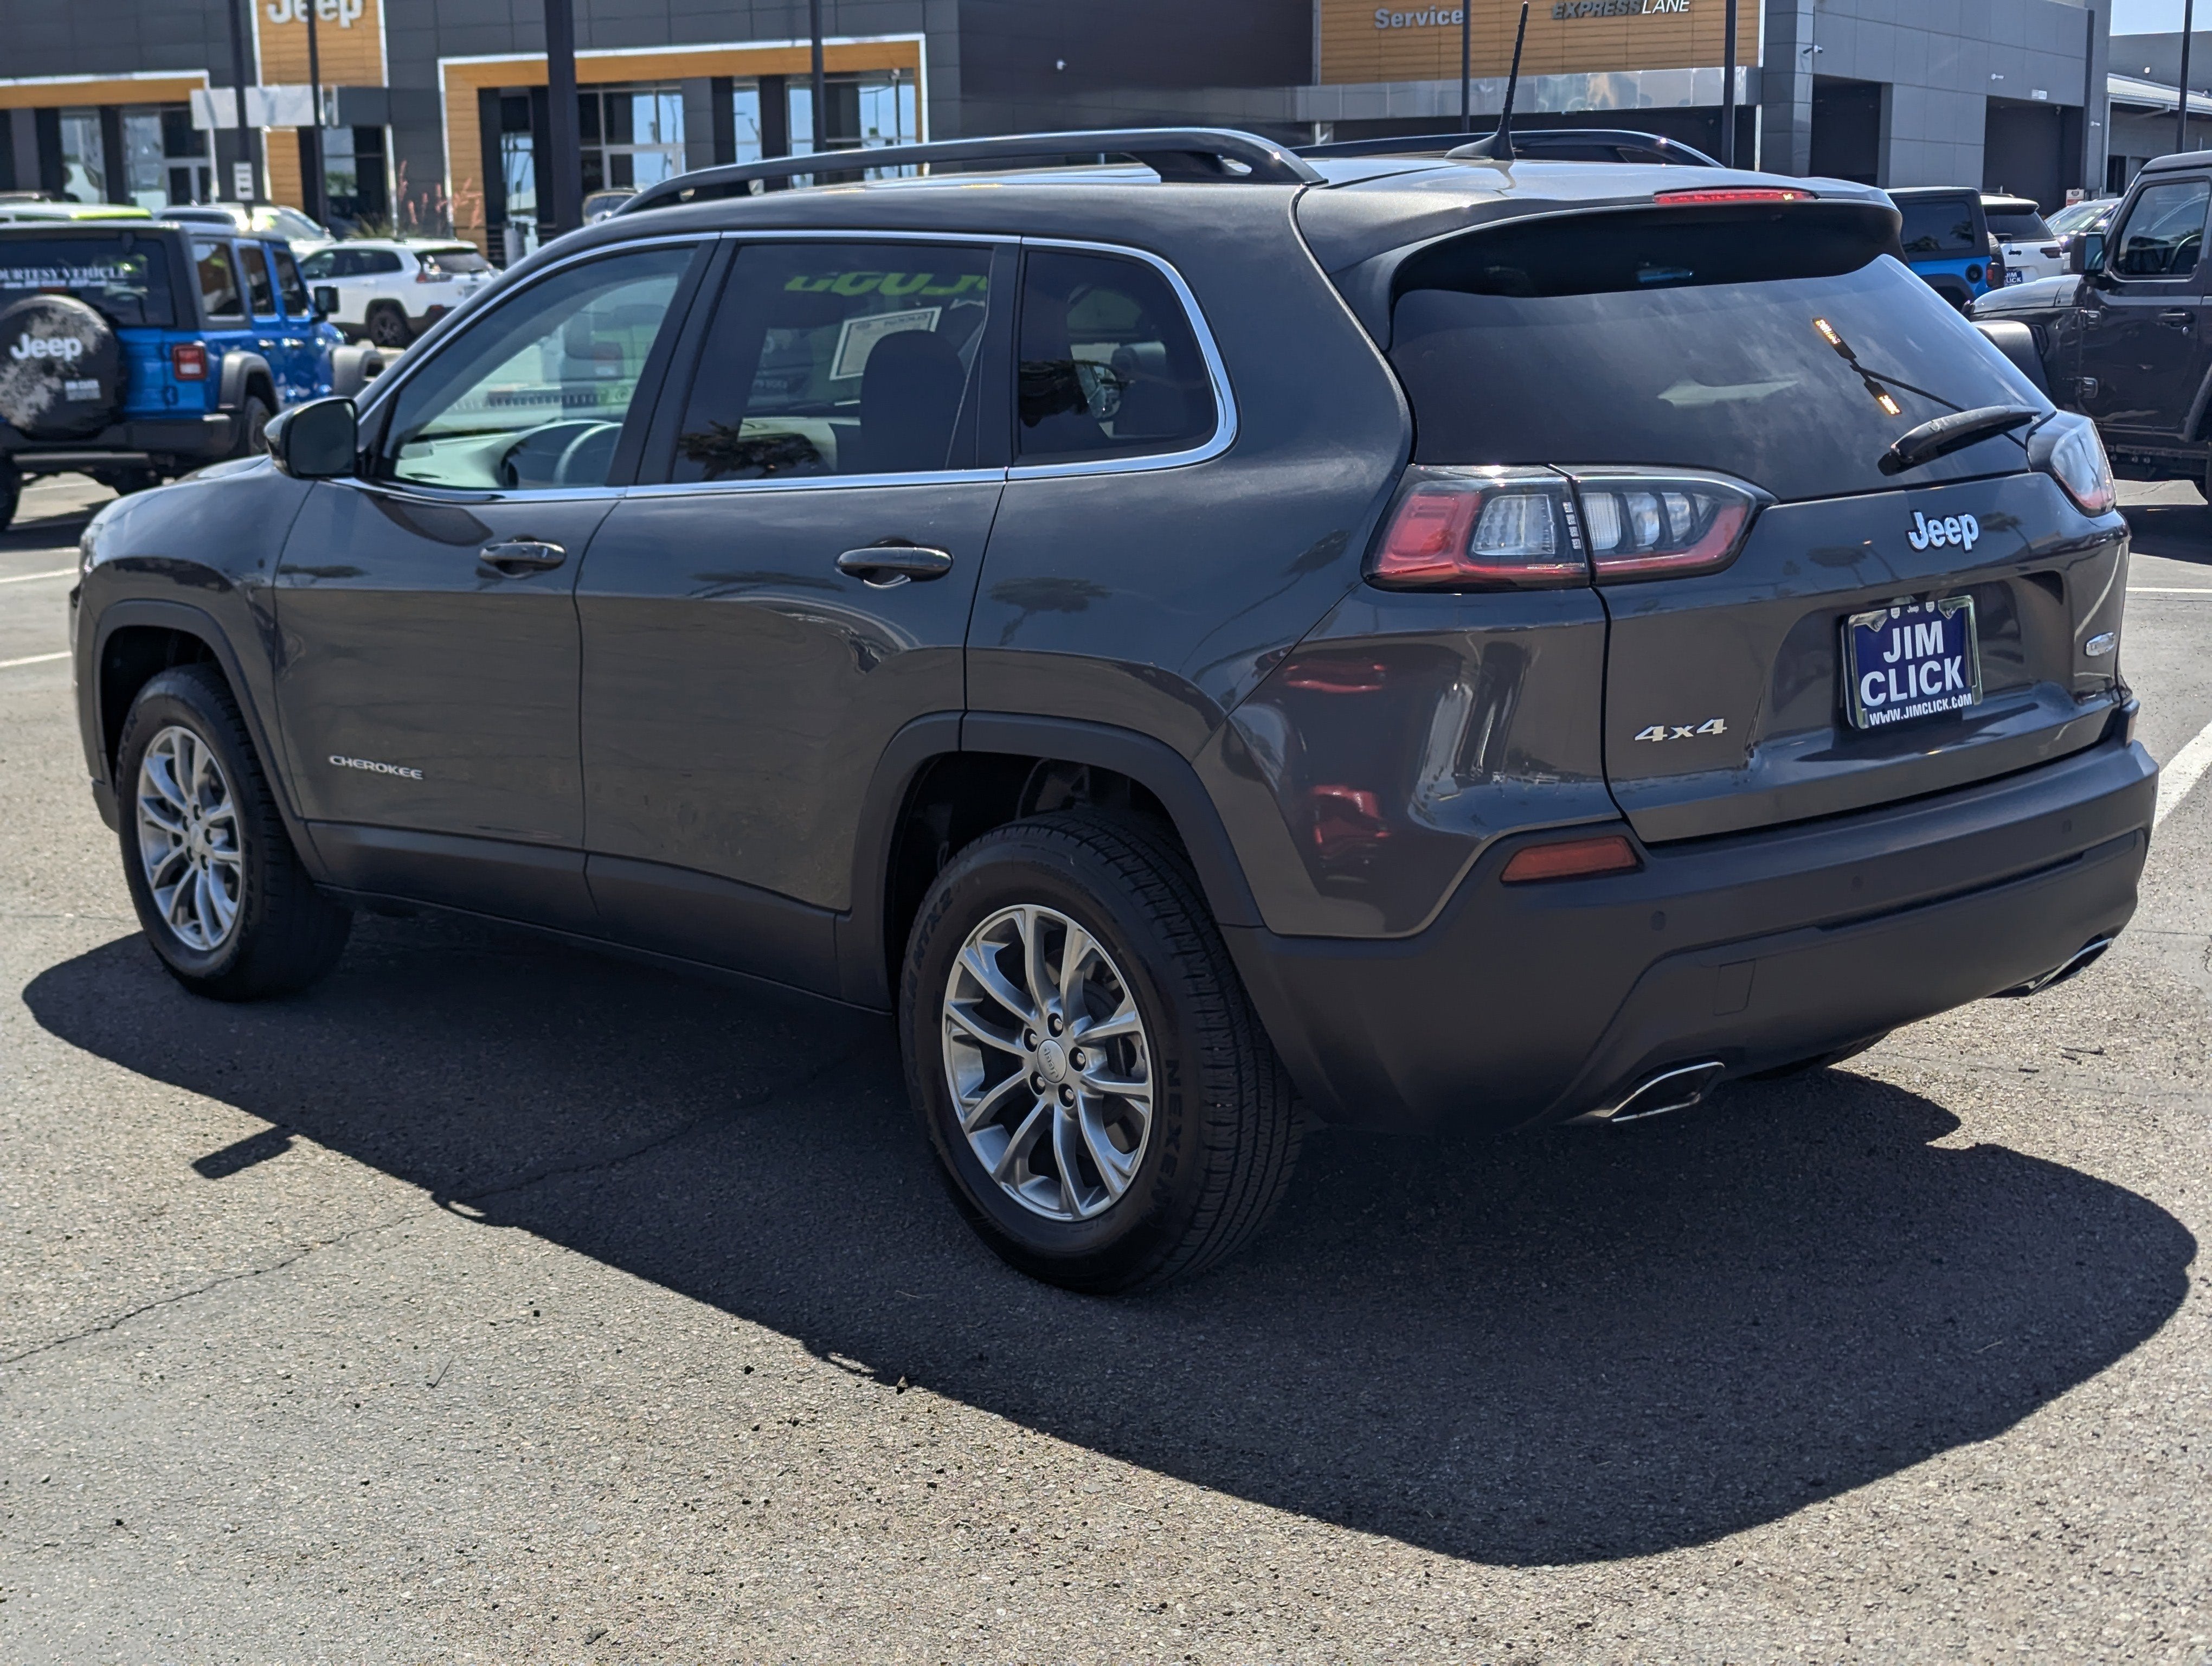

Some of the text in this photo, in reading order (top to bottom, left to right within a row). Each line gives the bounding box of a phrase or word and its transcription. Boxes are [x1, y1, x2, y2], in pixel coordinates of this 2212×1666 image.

[267, 0, 363, 28] Jeep
[1374, 5, 1463, 28] Service
[10, 333, 82, 362] Jeep
[1908, 511, 1979, 550] Jeep
[1883, 620, 1944, 663] JIM
[1861, 655, 1964, 706] CLICK
[1869, 693, 1972, 726] WWW.JIMCLICK.COM
[1635, 719, 1727, 741] 4x4
[329, 755, 423, 780] CHEROKEE
[1150, 1059, 1182, 1205] NEXEN
